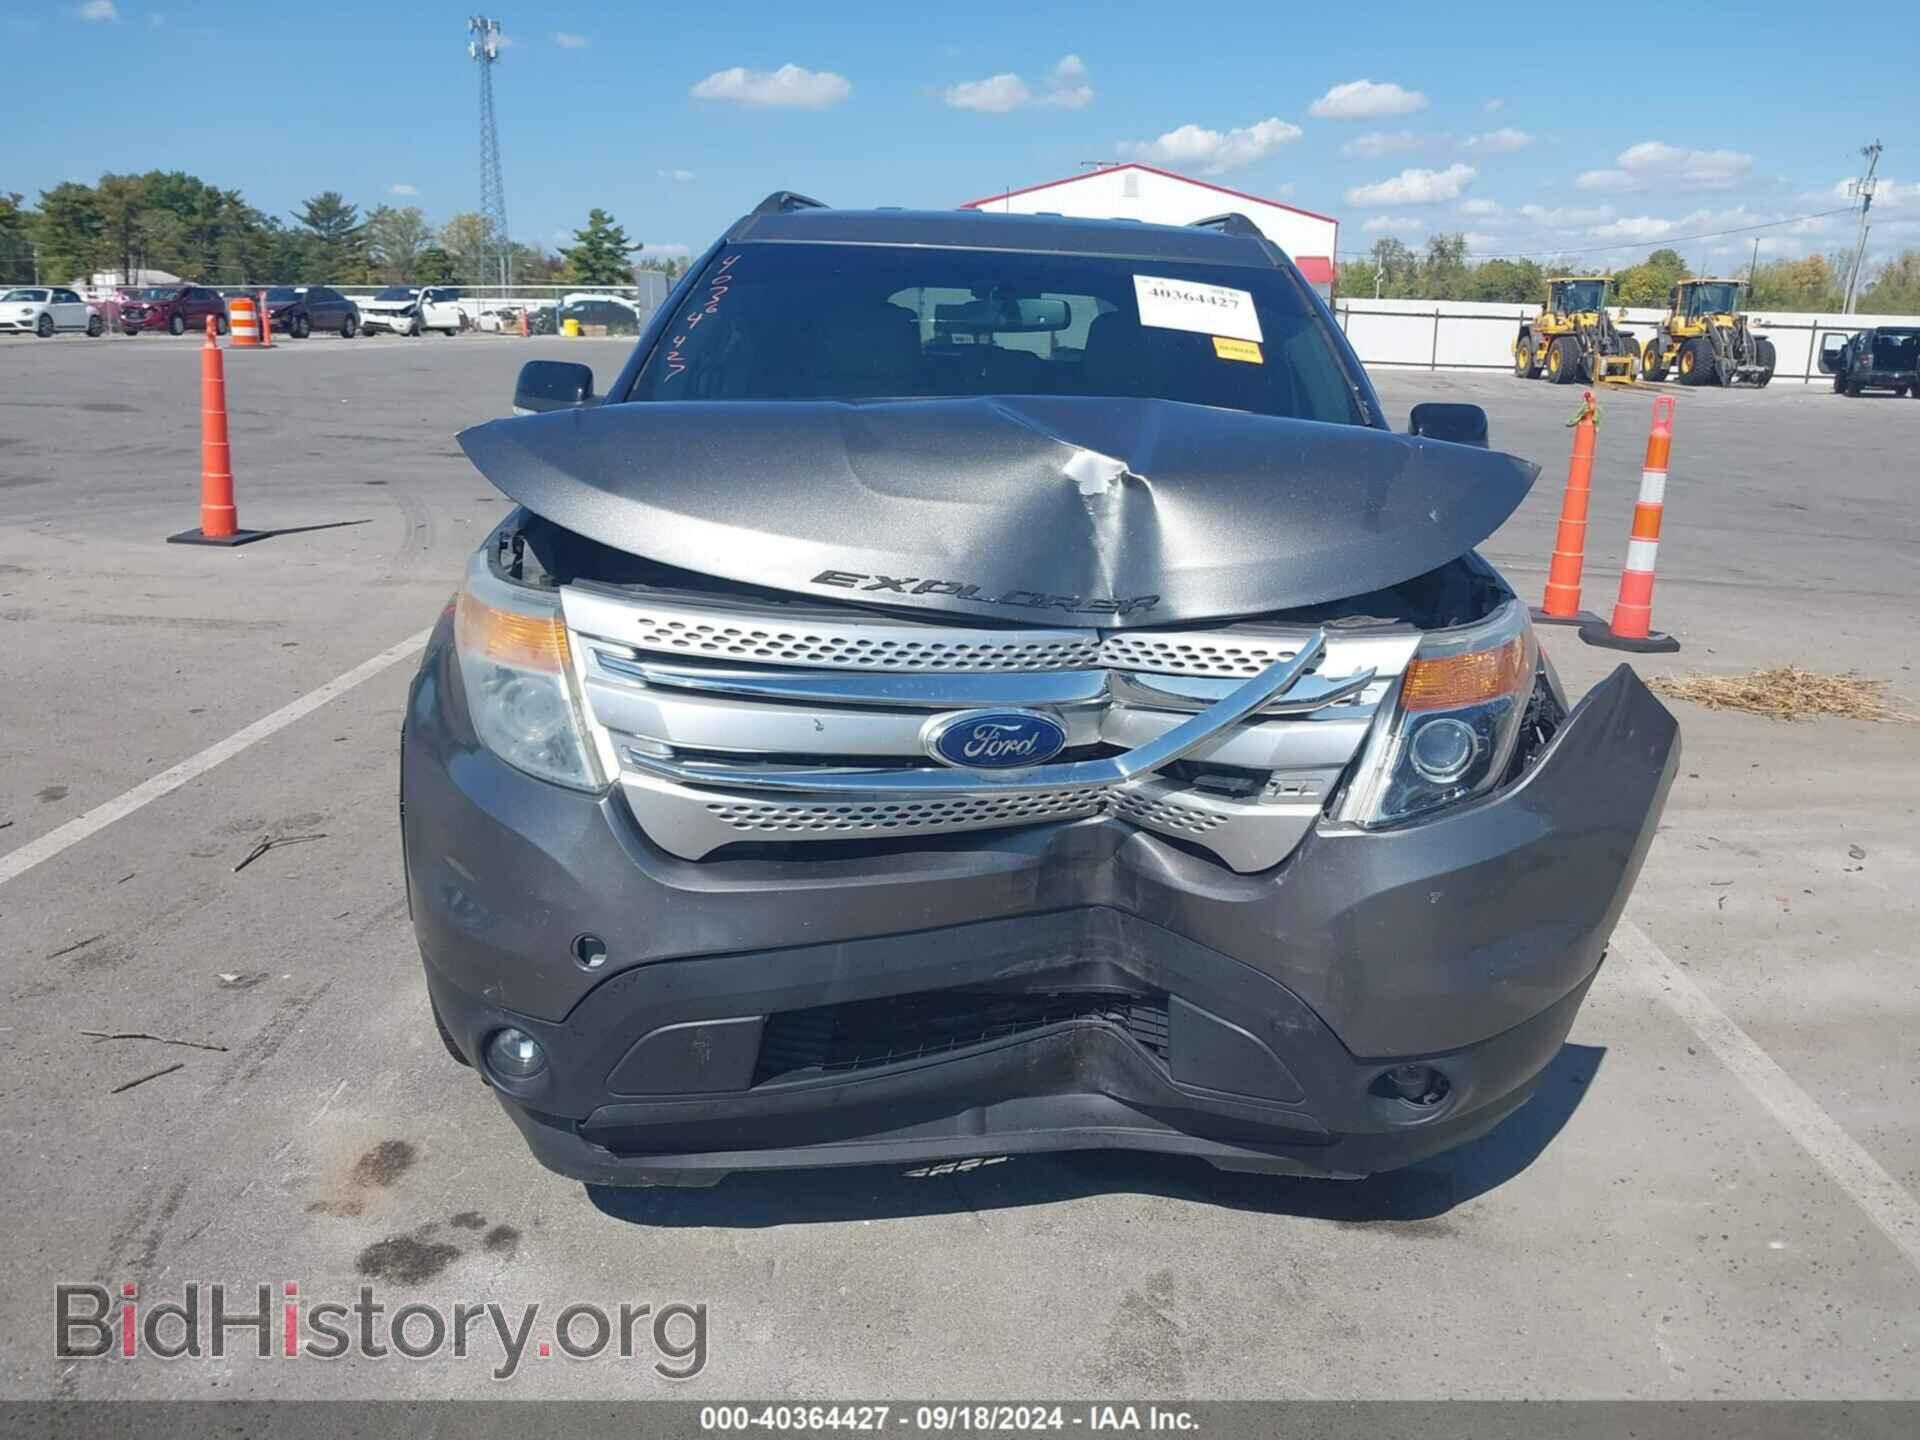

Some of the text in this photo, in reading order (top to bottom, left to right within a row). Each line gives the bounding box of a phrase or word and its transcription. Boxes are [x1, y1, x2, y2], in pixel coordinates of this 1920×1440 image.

[1149, 286, 1240, 311] 40364427
[663, 254, 742, 384] 40364427
[963, 723, 1040, 758] Ford
